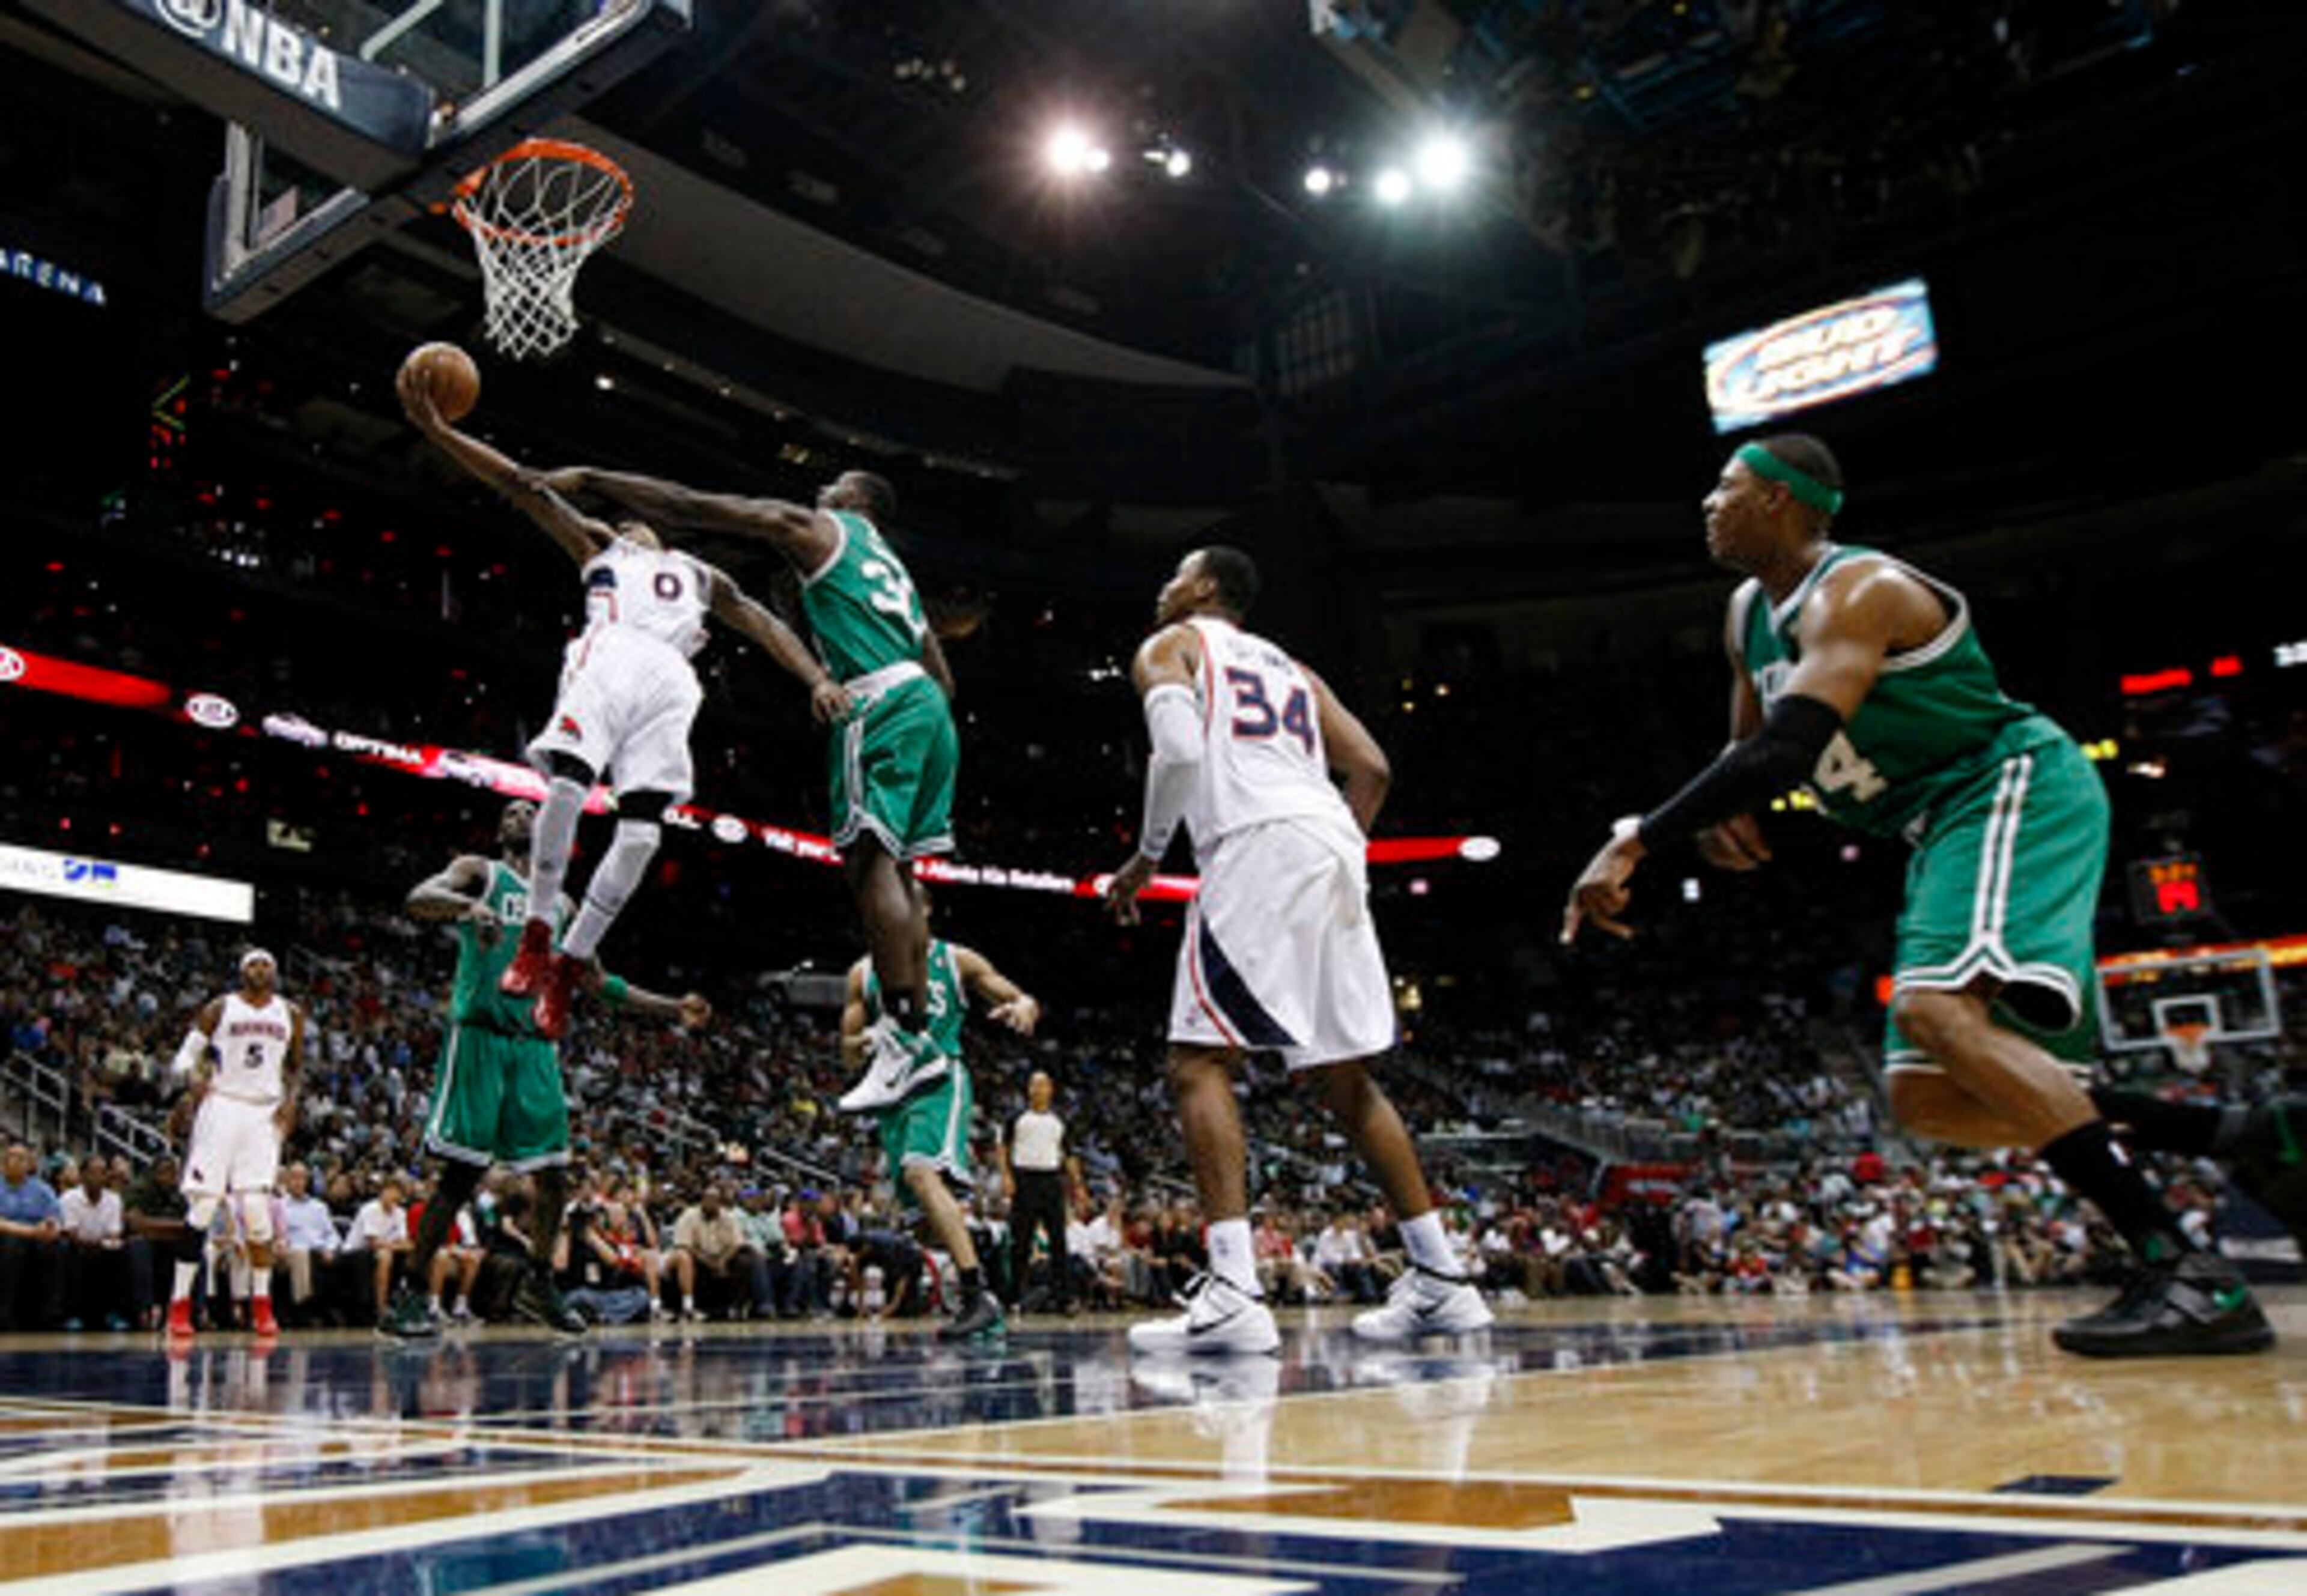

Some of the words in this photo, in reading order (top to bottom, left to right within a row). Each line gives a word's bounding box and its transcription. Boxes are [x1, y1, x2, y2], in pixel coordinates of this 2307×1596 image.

[654, 572, 683, 601] 0
[1224, 667, 1315, 757] 34
[243, 1043, 263, 1069] 5
